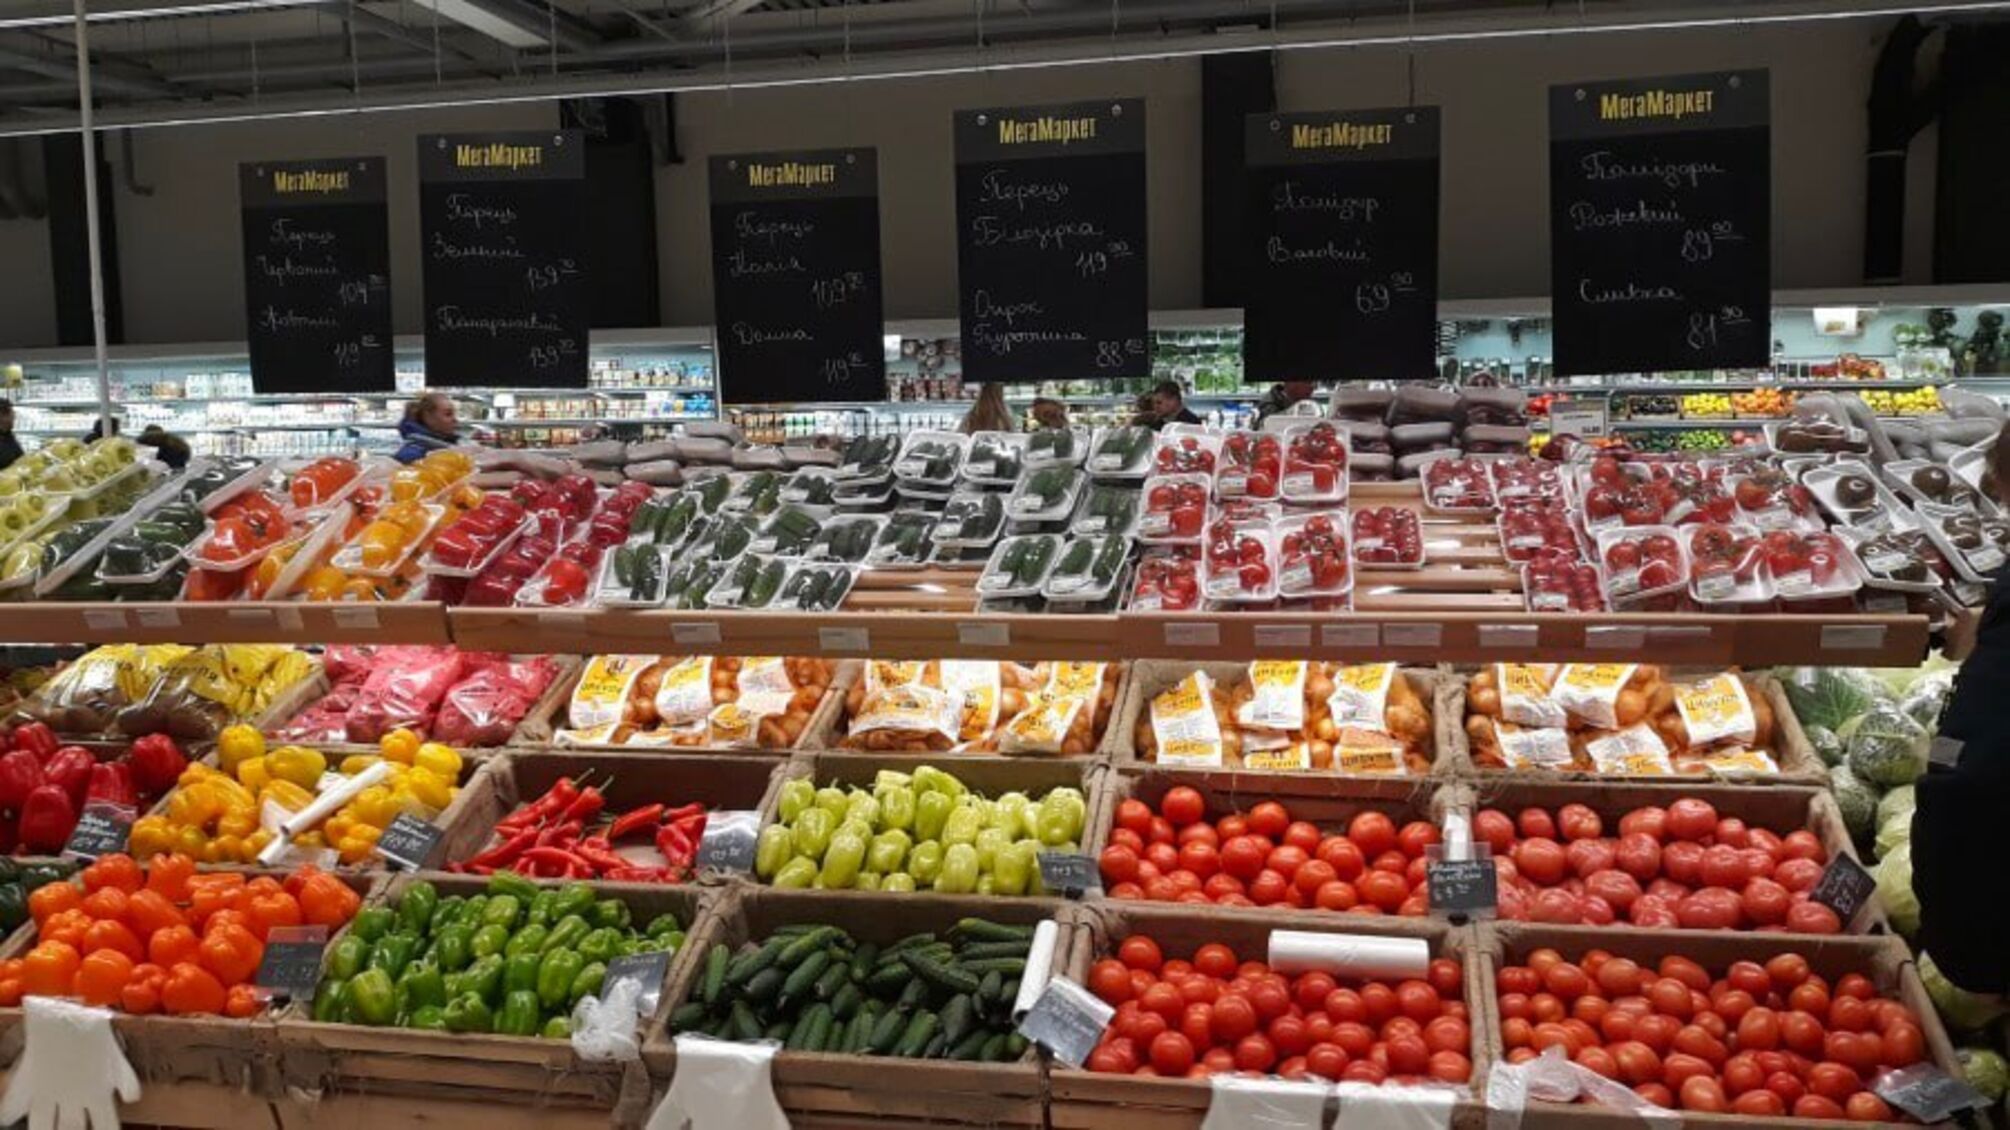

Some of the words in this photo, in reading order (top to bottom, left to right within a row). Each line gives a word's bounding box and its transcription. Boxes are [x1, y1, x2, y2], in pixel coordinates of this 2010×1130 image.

[1600, 90, 1713, 119] МегаМаркет
[1000, 117, 1096, 144] МегаМаркет
[1292, 122, 1393, 149] МегаМаркет
[456, 143, 543, 170] МегаМаркет
[274, 170, 349, 194] МегаМаркет
[749, 163, 835, 187] МегаМаркет
